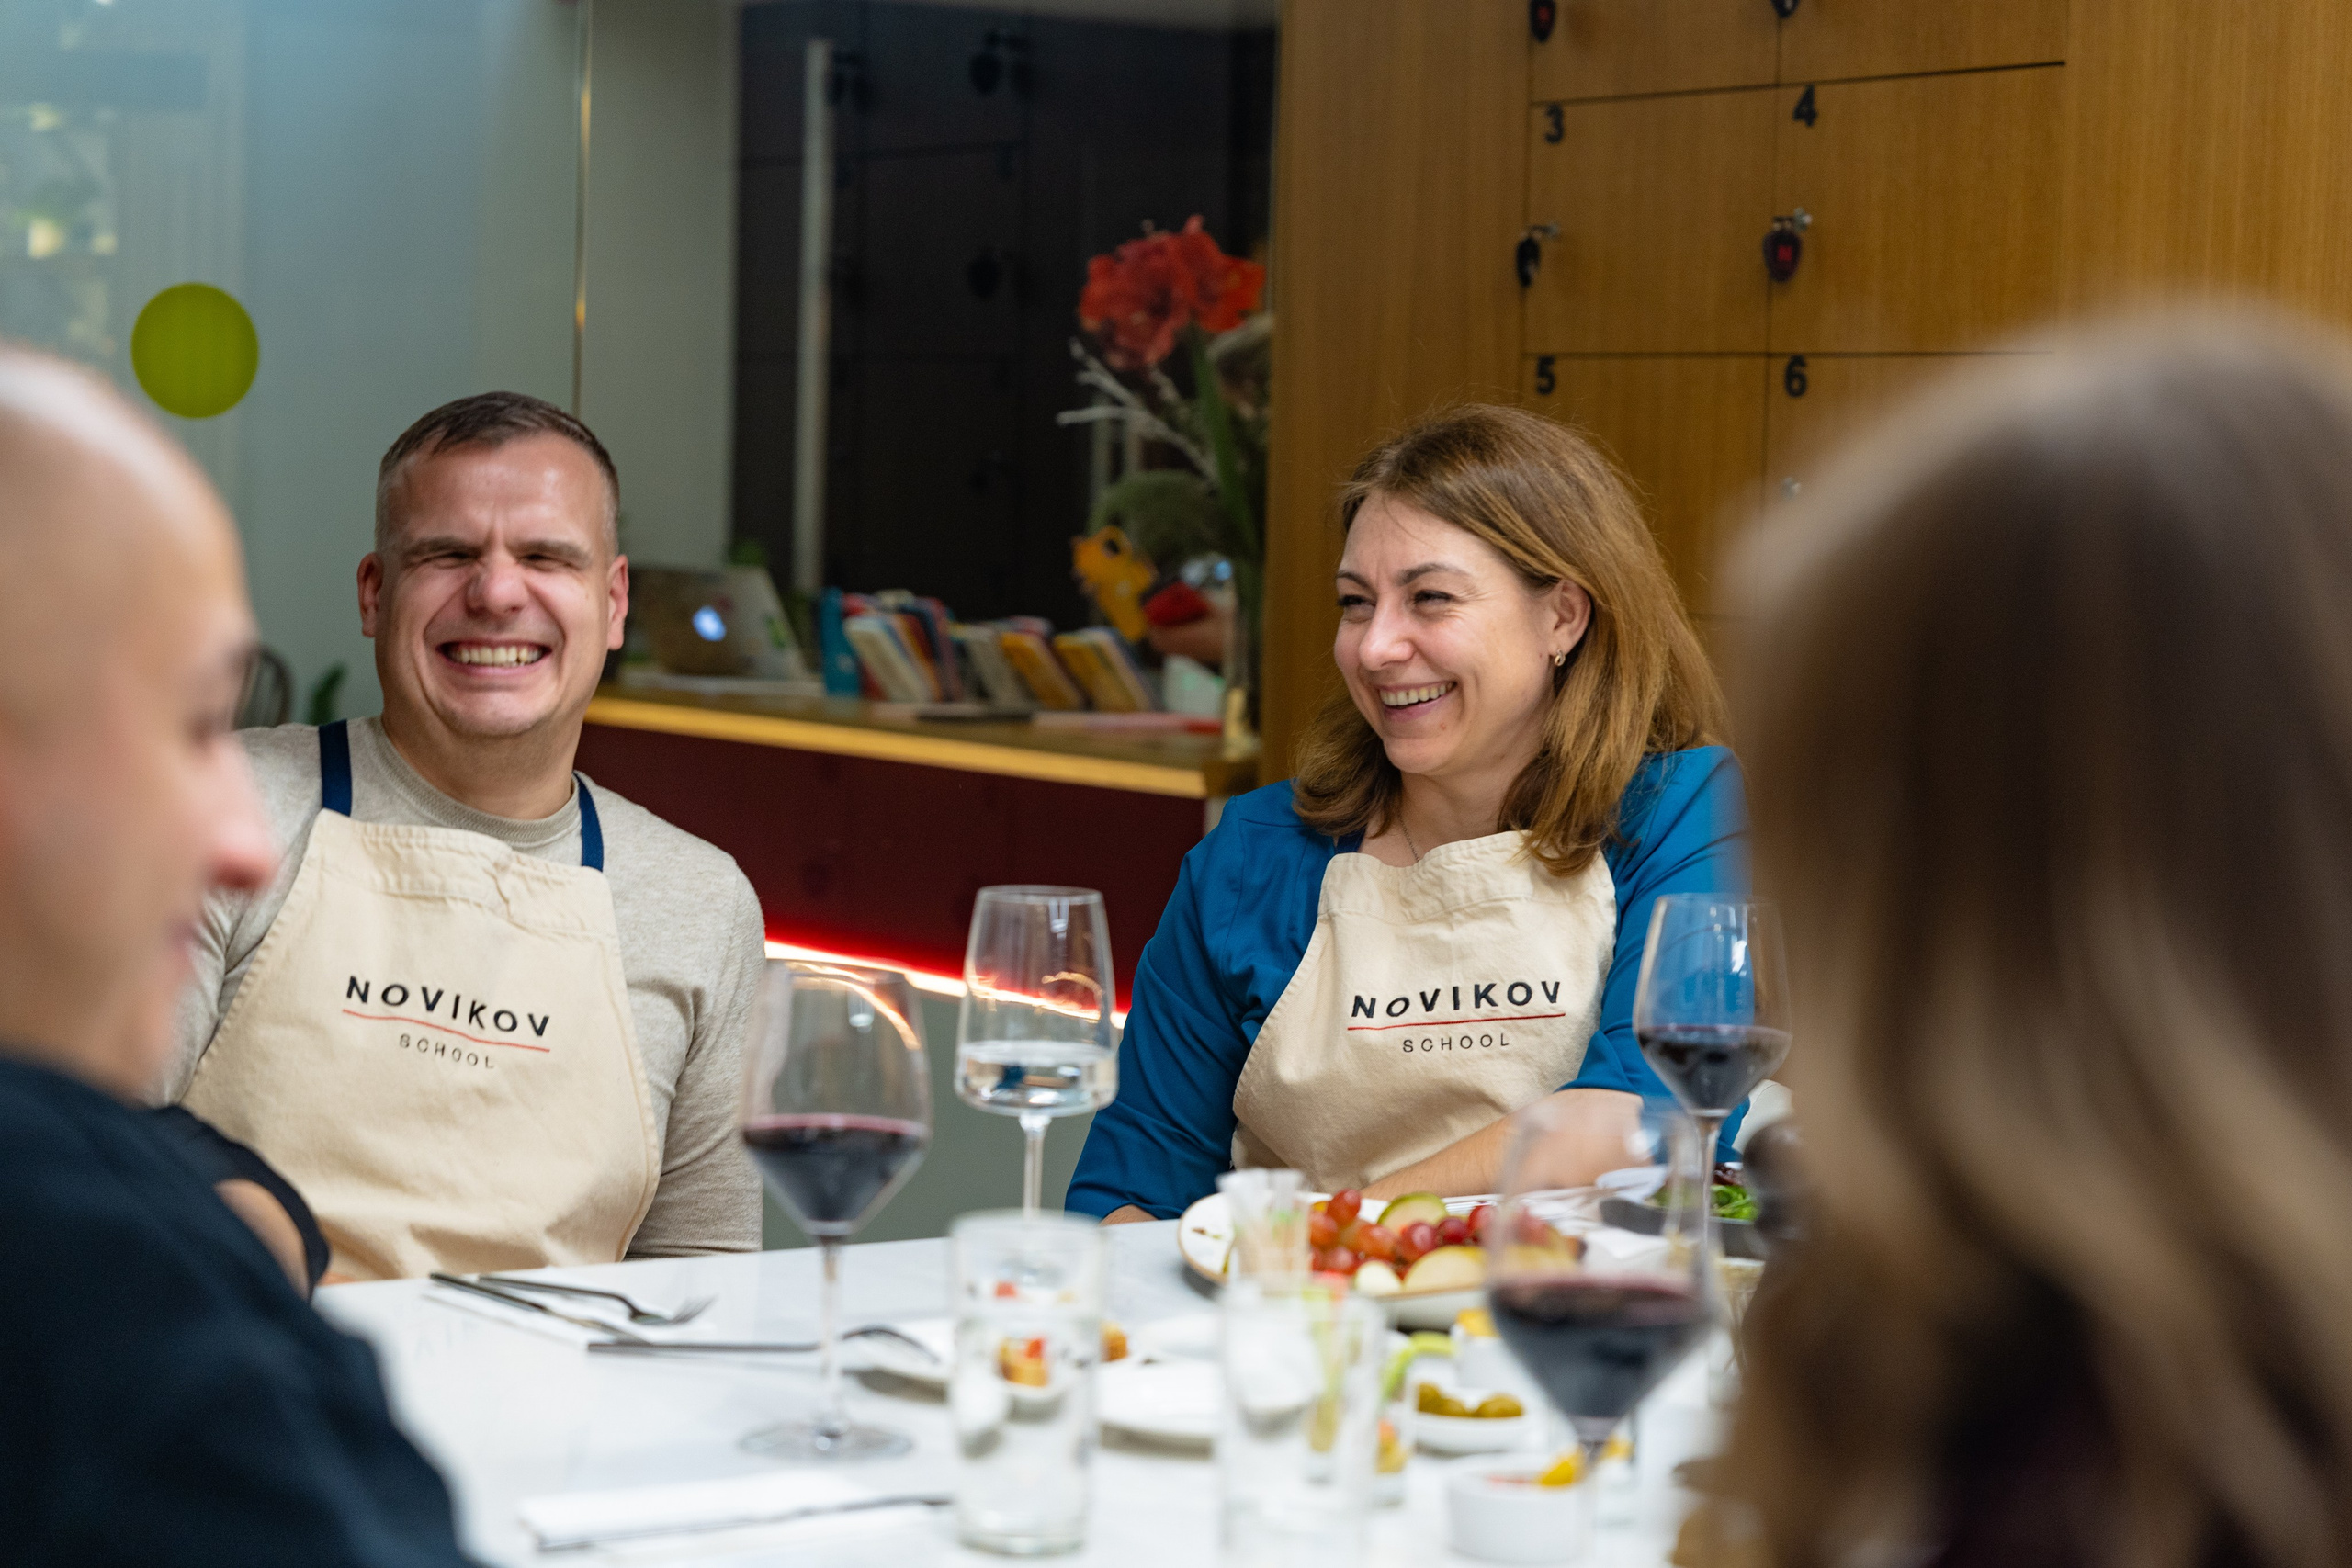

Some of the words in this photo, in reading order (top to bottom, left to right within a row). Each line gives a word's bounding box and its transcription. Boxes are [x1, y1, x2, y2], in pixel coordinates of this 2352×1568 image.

[1544, 103, 1565, 144] 3
[1792, 85, 1817, 127] 4
[1536, 356, 1555, 395] 5
[1785, 355, 1807, 397] 6
[345, 975, 550, 1037] NOVIKOV
[1351, 980, 1561, 1019] NOVIKOV
[400, 1033, 495, 1069] SCHOOL
[1402, 1032, 1510, 1053] SCHOOL
